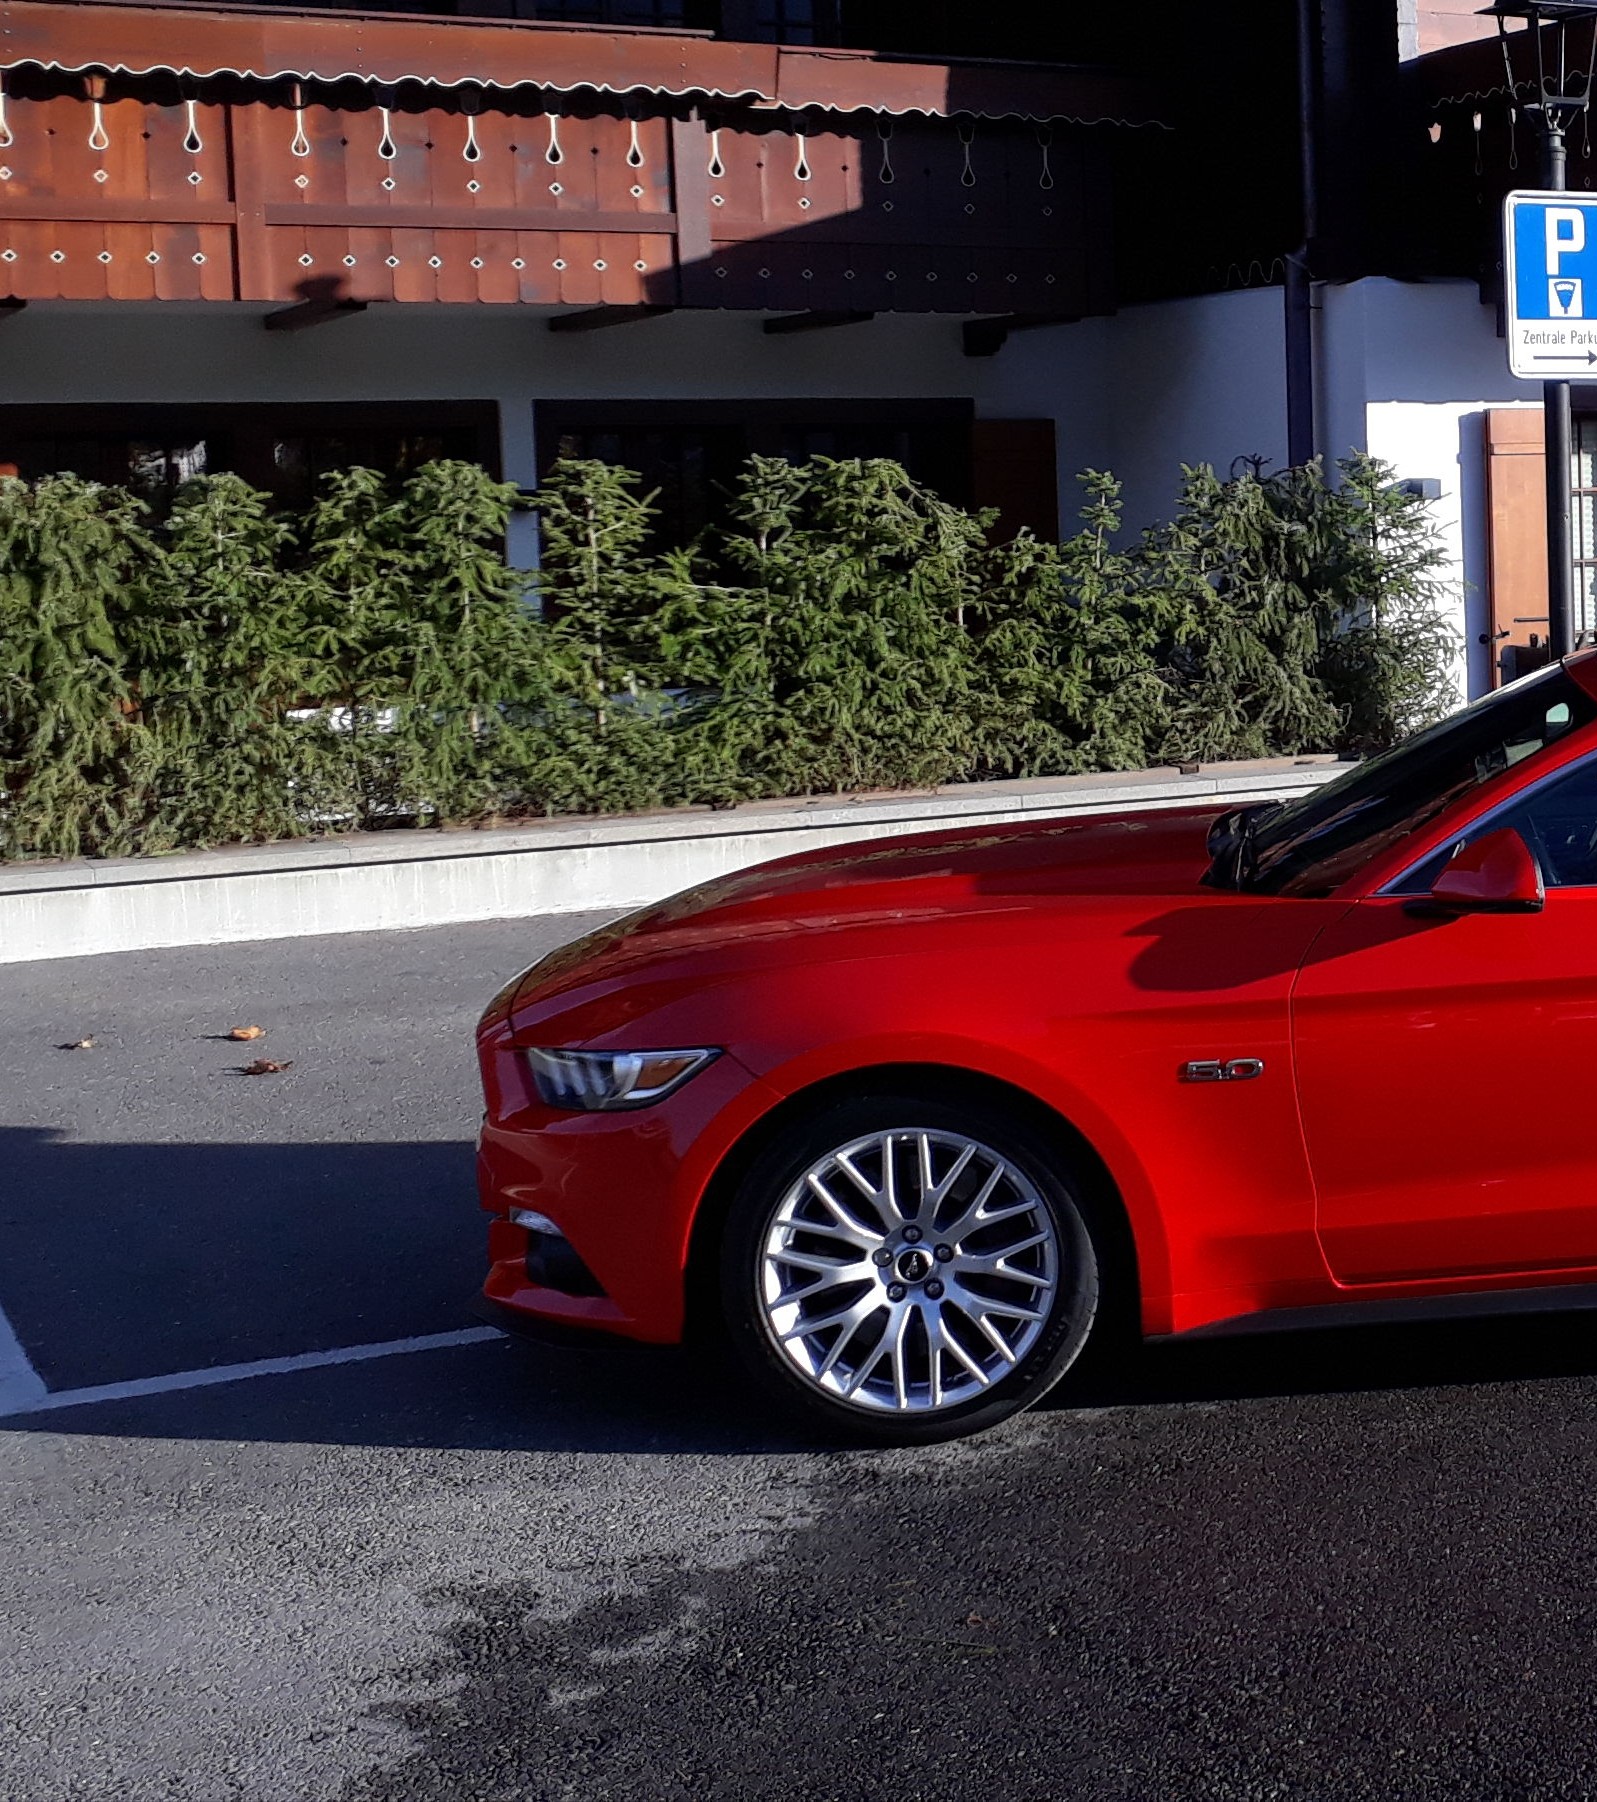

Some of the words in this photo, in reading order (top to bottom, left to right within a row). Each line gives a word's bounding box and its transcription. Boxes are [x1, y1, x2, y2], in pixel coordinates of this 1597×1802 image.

[1545, 207, 1585, 275] P
[1522, 329, 1566, 345] Zentrale
[1186, 1058, 1264, 1080] 5.0
